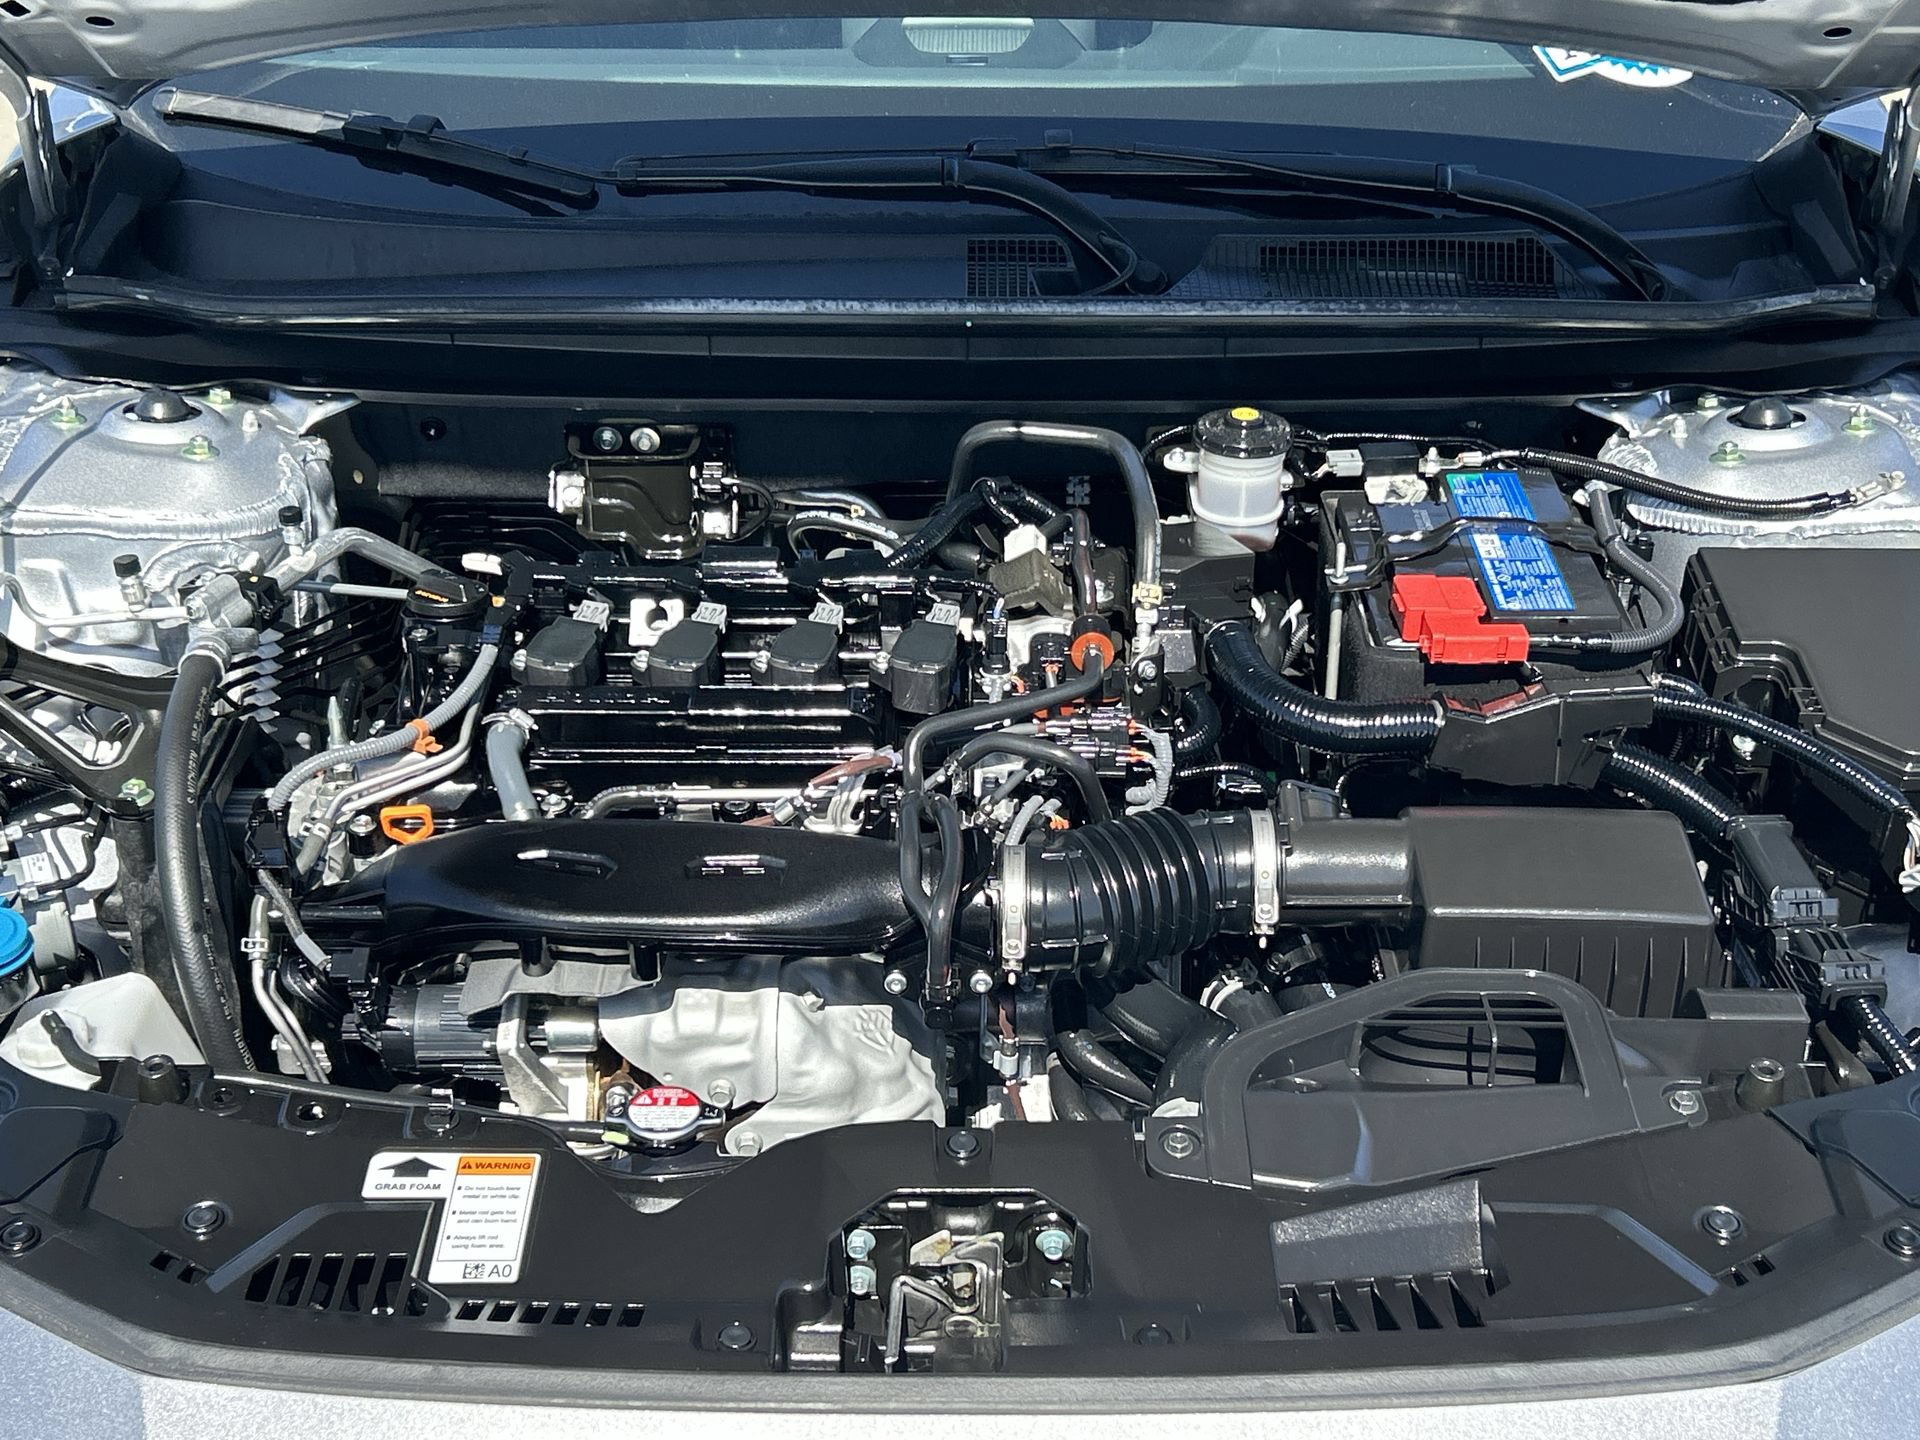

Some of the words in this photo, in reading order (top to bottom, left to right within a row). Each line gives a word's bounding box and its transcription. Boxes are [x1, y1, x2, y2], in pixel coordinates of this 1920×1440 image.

[475, 1161, 531, 1170] WARNING
[374, 1183, 407, 1191] GRAB
[409, 1183, 442, 1191] FOAM
[487, 1263, 513, 1278] A0
